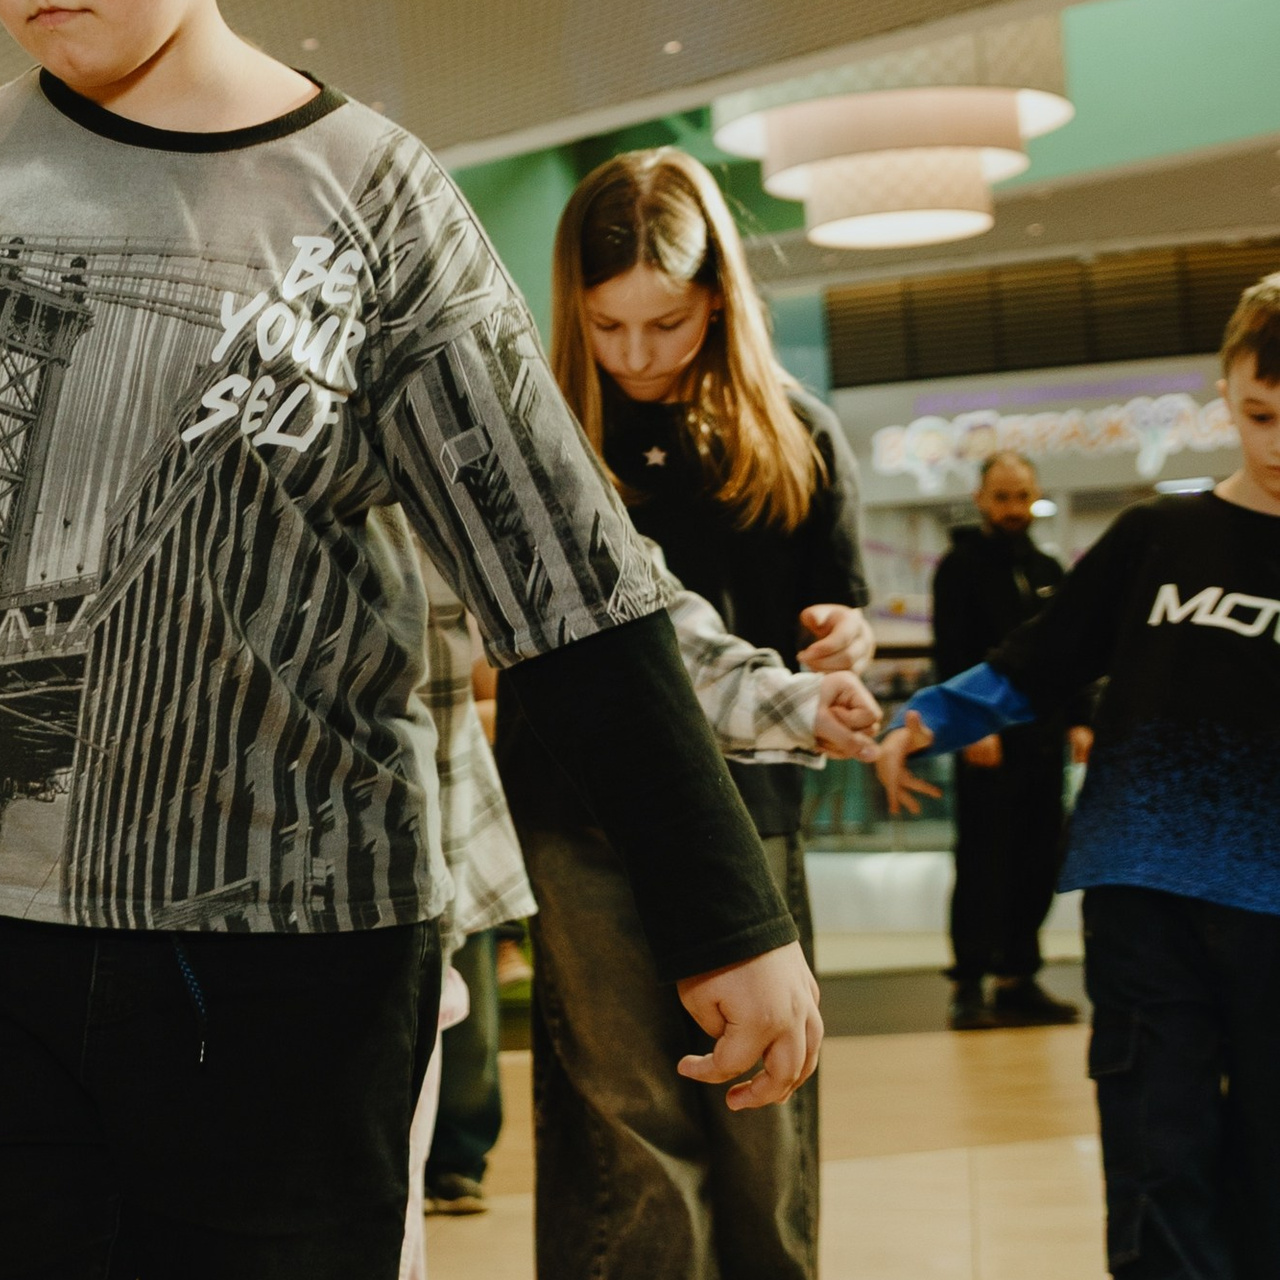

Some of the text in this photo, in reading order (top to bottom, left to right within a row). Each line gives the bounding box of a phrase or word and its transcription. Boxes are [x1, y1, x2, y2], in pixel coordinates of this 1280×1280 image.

[282, 235, 363, 304] BE
[211, 290, 367, 390] YOUR
[181, 373, 349, 453] SELF
